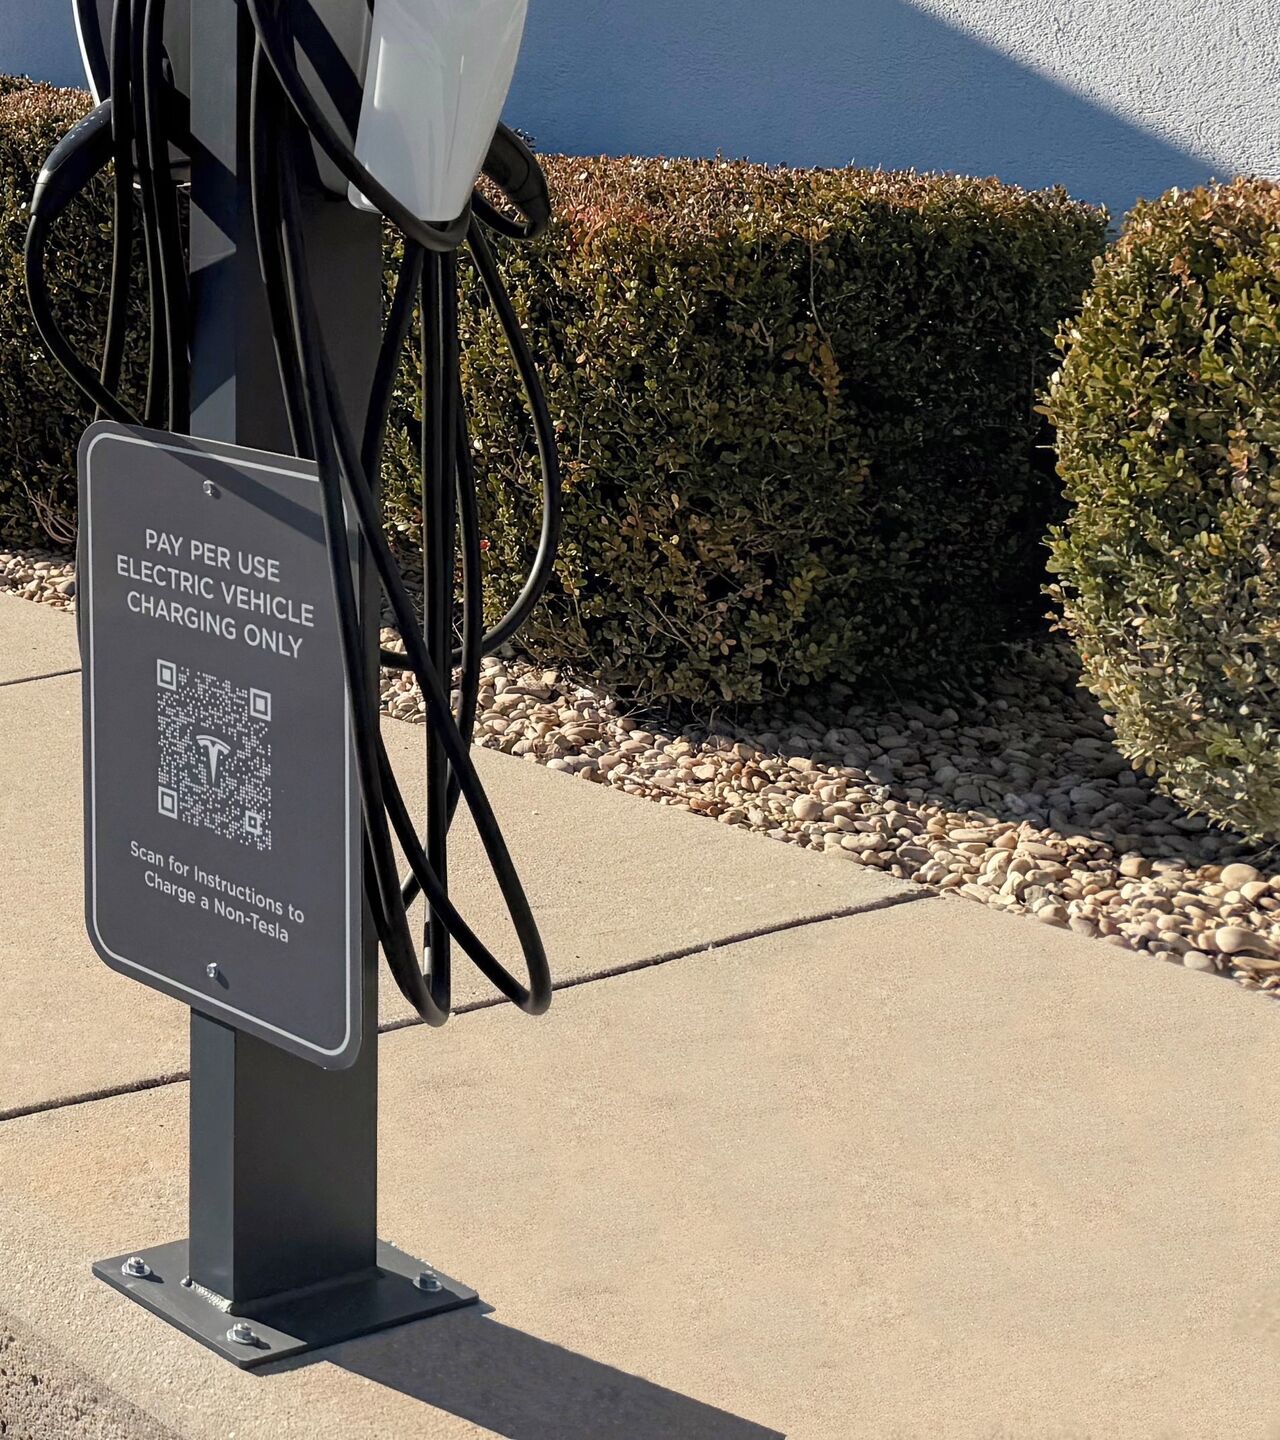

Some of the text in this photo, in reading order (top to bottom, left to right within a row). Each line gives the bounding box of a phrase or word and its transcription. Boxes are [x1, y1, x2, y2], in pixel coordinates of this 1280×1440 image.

[117, 554, 314, 627] ELECTRIC VEHICLE
[146, 528, 280, 583] PAY PER USE
[127, 591, 303, 659] CHARGING ONLY
[130, 840, 305, 923] Scan for Instructions to
[144, 870, 288, 943] Charge a Non-Tesla
